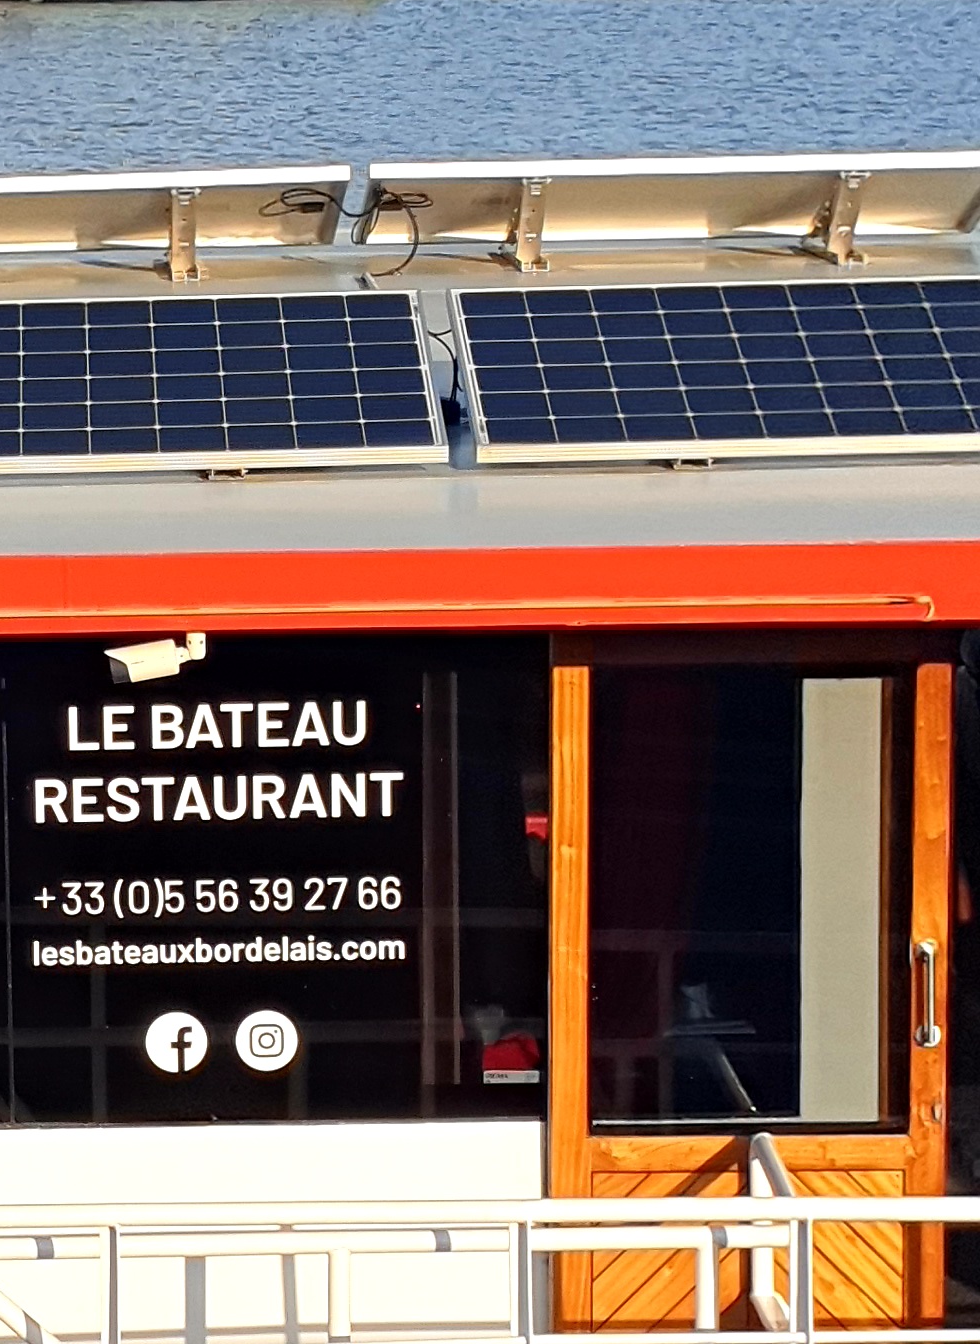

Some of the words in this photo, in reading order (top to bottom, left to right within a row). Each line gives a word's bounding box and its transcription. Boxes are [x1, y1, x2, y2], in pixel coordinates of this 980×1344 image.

[67, 705, 136, 751] LE
[151, 699, 367, 750] BATEAU
[34, 771, 404, 824] RESTAURANT
[113, 877, 185, 919] (0)5
[195, 878, 239, 913] 56
[249, 877, 293, 912] 39
[303, 877, 349, 911] 27
[357, 875, 402, 910] 66
[33, 934, 406, 967] lesbateauxbordelais.com
